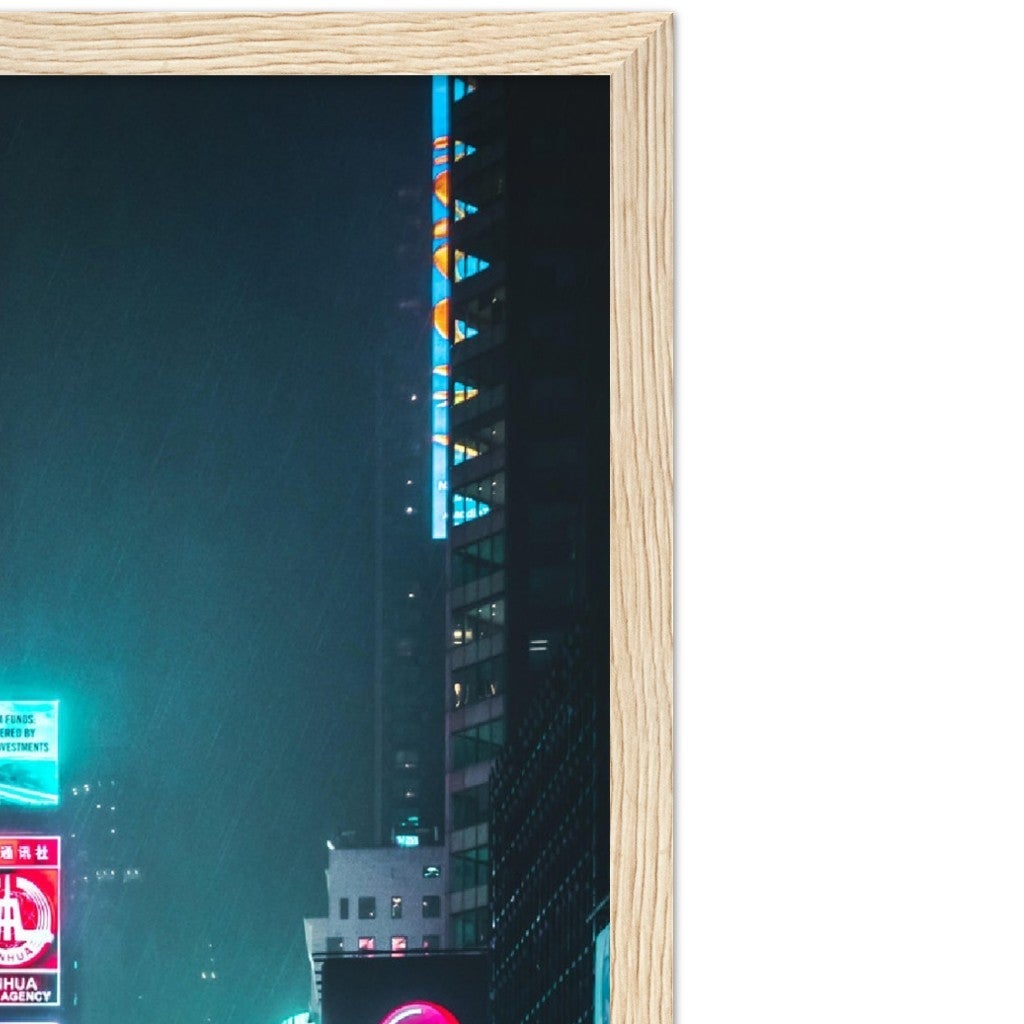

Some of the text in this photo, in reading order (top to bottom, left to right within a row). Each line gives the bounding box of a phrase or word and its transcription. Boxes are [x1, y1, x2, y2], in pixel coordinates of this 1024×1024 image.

[5, 714, 34, 724] FUNDS
[24, 728, 36, 738] BY
[0, 991, 52, 1002] AGENCY
